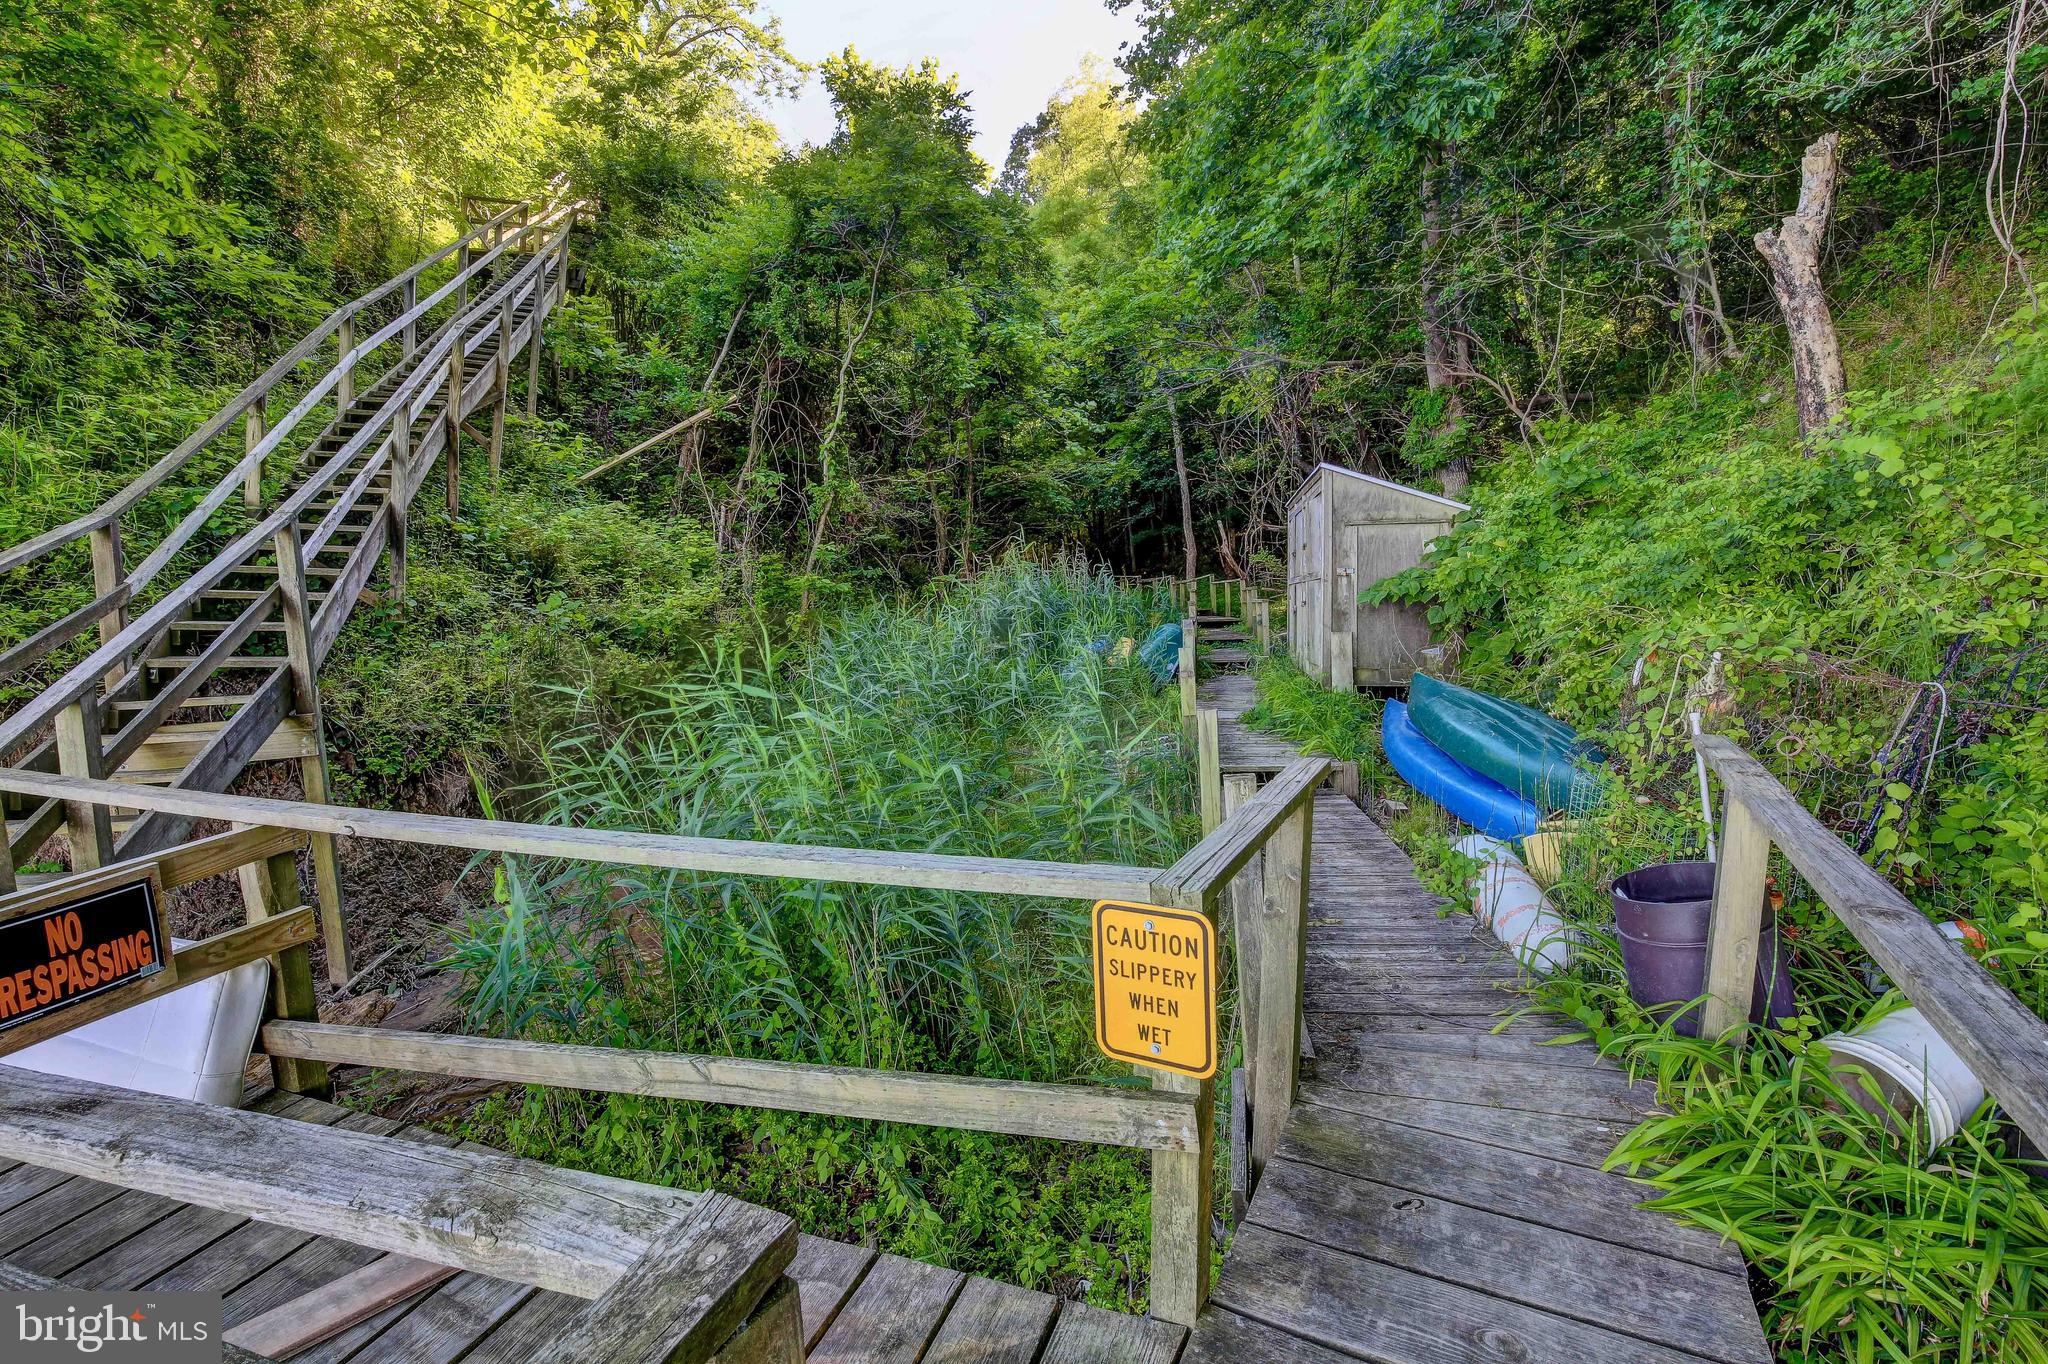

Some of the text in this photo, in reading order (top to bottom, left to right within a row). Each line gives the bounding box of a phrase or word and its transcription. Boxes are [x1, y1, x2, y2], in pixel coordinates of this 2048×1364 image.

[44, 911, 83, 957] NO
[1106, 925, 1199, 959] CAUTION
[0, 930, 152, 1018] RESPASSING
[1109, 958, 1197, 990] SLIPPERY
[1128, 991, 1179, 1018] WHEN
[1137, 1023, 1171, 1046] WET
